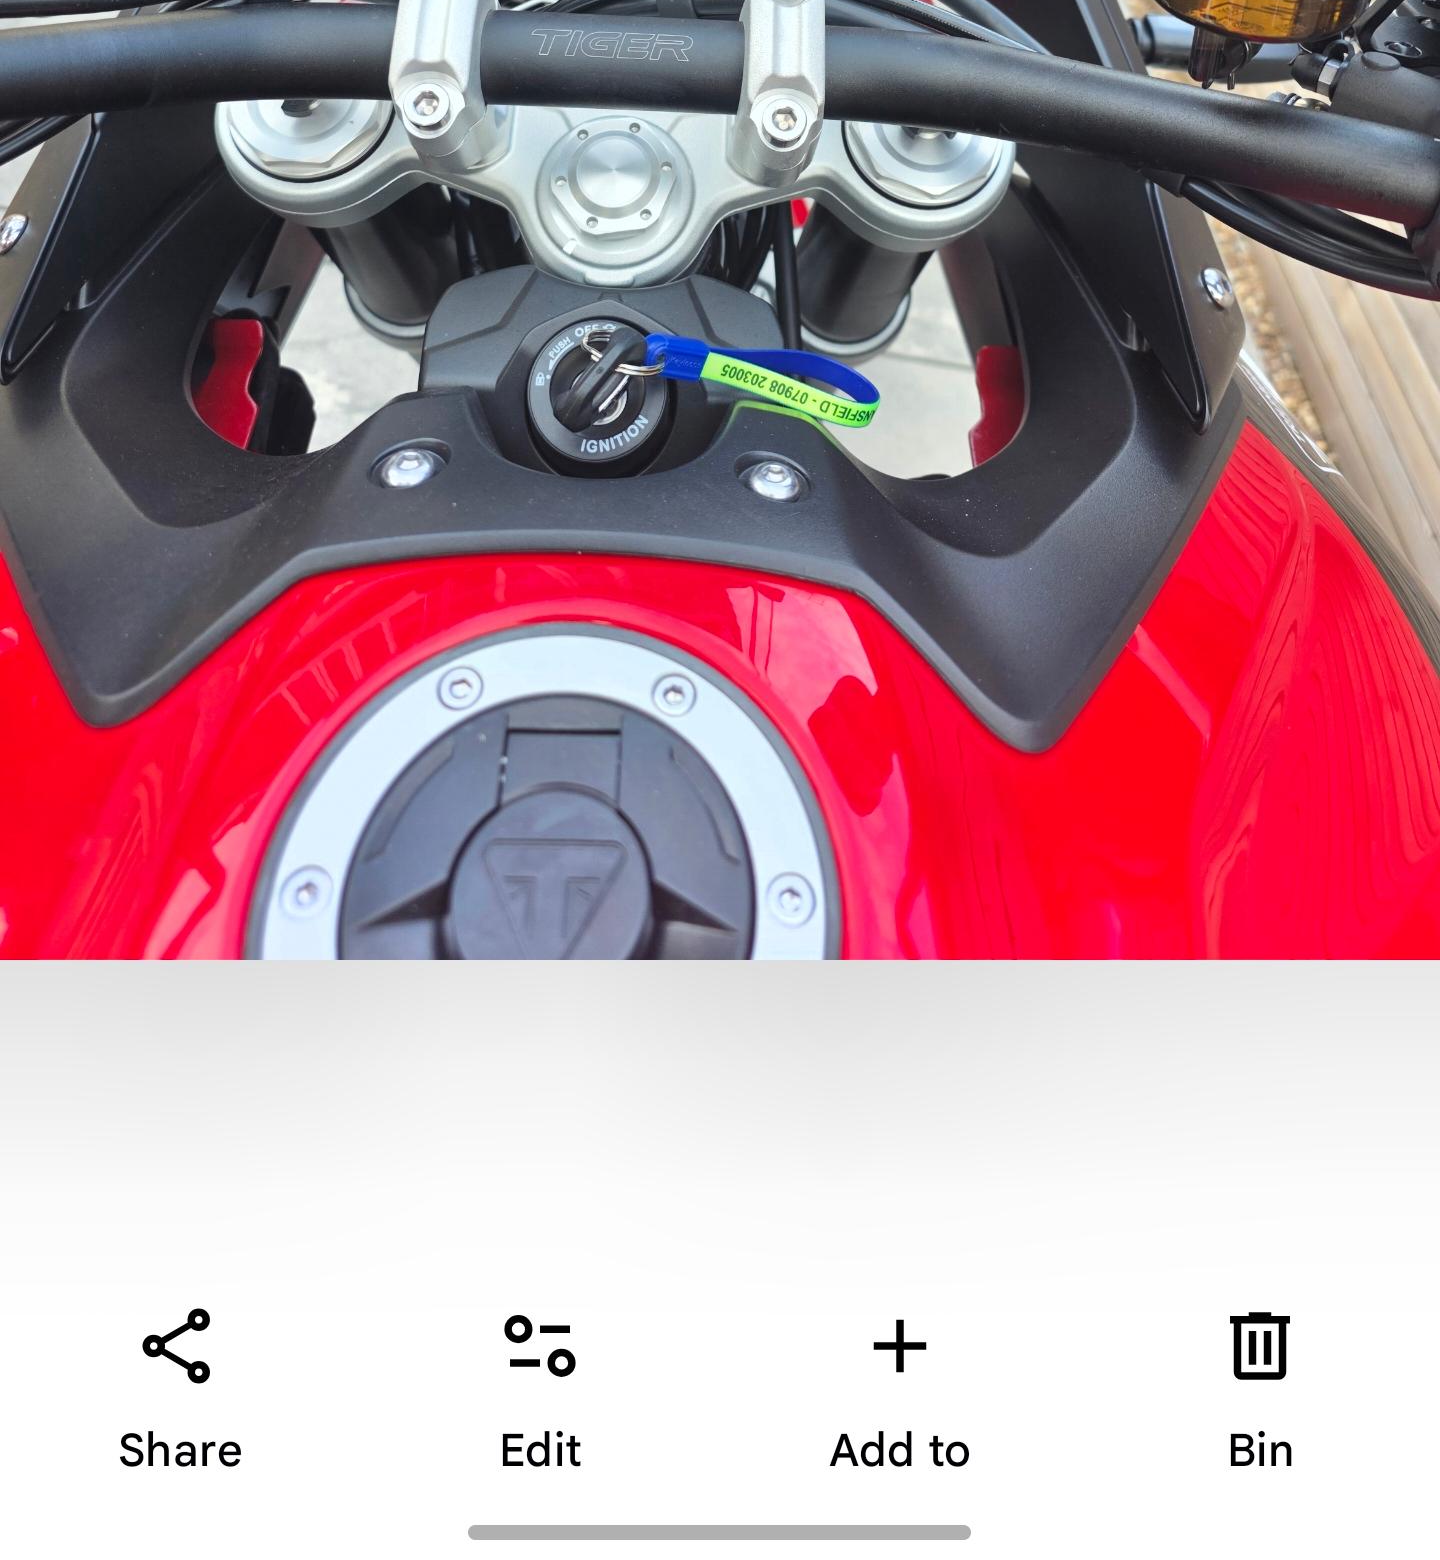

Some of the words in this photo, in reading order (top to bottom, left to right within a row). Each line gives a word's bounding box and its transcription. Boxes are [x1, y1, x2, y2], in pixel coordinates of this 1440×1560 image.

[531, 28, 694, 62] TIGER
[548, 336, 571, 359] PUSH
[721, 364, 768, 389] 203005
[768, 380, 809, 404] 07908
[580, 415, 649, 453] IGNITION
